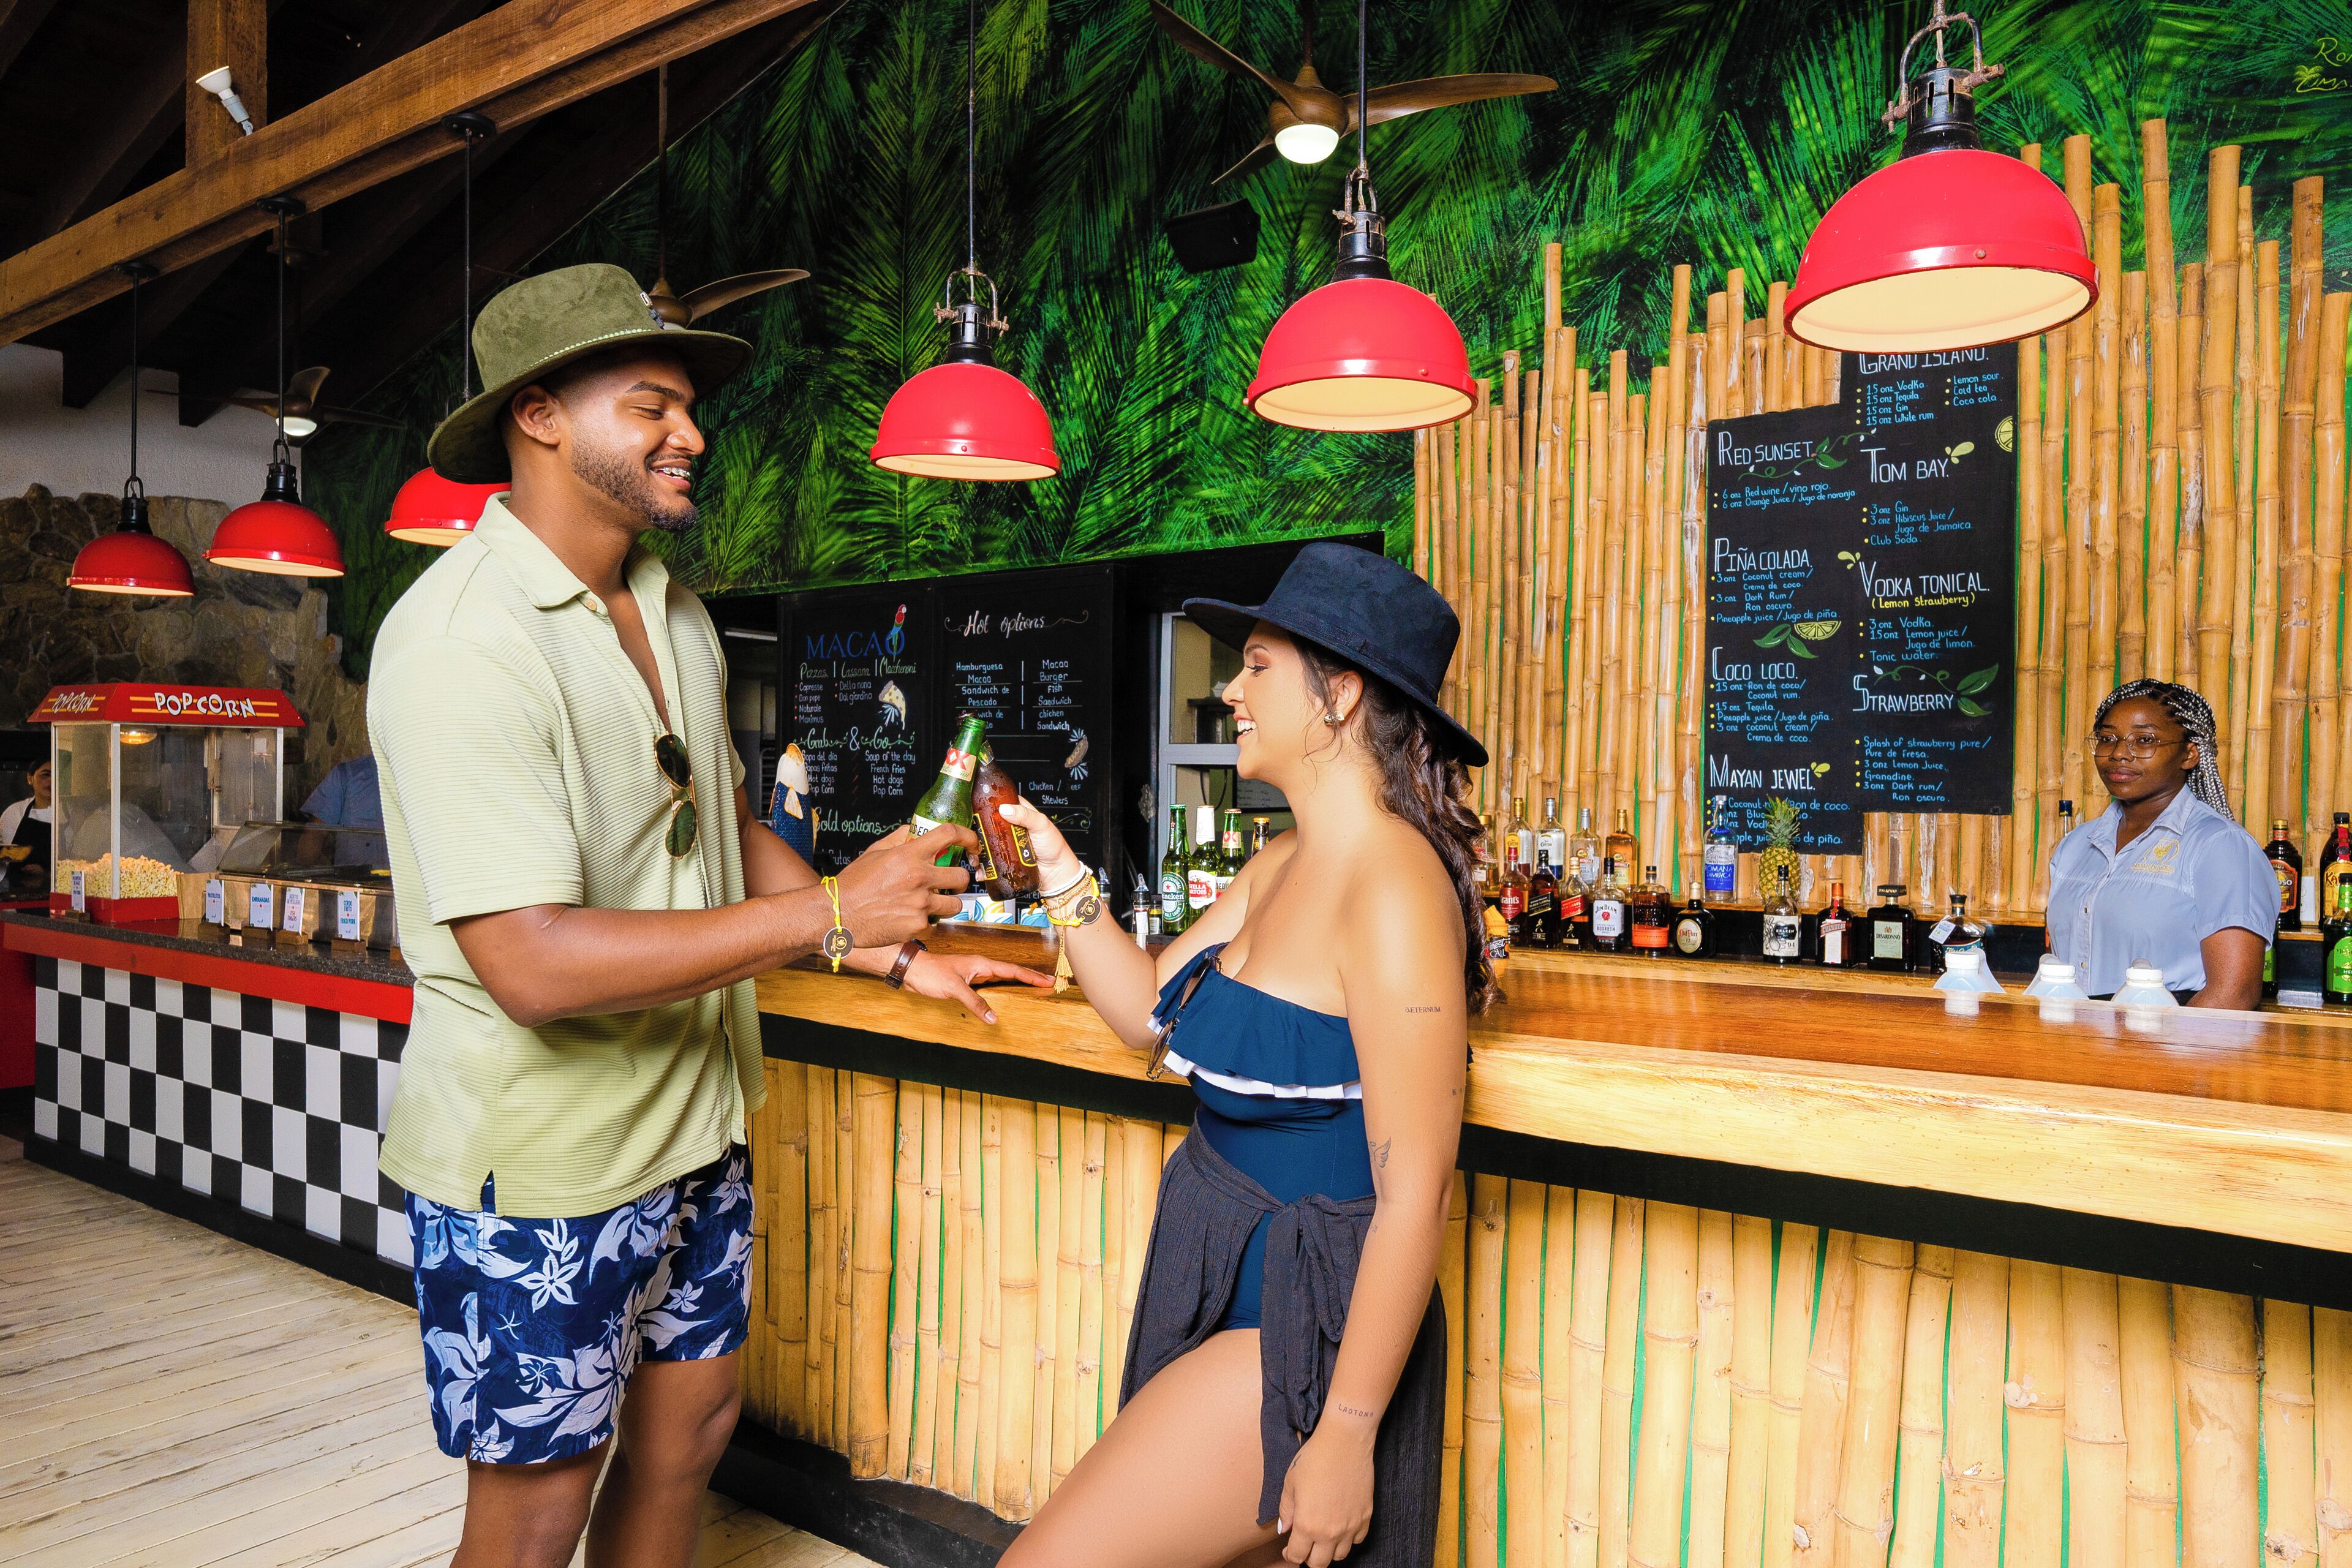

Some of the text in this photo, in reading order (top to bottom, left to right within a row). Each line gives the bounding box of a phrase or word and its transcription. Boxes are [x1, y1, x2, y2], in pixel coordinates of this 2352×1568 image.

[1954, 375, 1978, 385] Lemon
[1954, 386, 1971, 396] Cold
[1953, 397, 1974, 406] Coca
[1894, 413, 1917, 423] White
[1755, 441, 1813, 462] SUNSET
[1860, 448, 1906, 483] TOM
[1746, 486, 1759, 497] Red
[1790, 484, 1808, 493] vino
[1746, 498, 1770, 510] Orange
[1798, 492, 1815, 505] Jugo
[1817, 491, 1826, 500] de
[1895, 514, 1926, 524] Hibiscus
[1928, 510, 1946, 521] Juice
[1894, 524, 1929, 537] Jugo de
[1871, 535, 1891, 545] Club
[1760, 549, 1812, 571] COLADA.
[1743, 571, 1773, 581] Coconut
[1859, 562, 1990, 597] VODKA TONICAL.
[1717, 610, 1813, 624] Pineapple juice Jugo de
[964, 611, 1046, 638] Hot options
[1906, 629, 1934, 638] Lemon
[1938, 630, 1959, 641] juice
[807, 628, 905, 660] MACAO
[1905, 639, 1940, 652] Jugo de
[1869, 651, 1896, 661] Tonic
[956, 663, 1003, 673] Hamburguesa
[1042, 660, 1068, 669] Macao
[1713, 647, 1798, 680] COCO LOCO.
[968, 674, 992, 683] Macao
[1040, 672, 1068, 684] Burger
[840, 680, 856, 690] Della
[1748, 681, 1776, 690] Ron de
[1748, 691, 1777, 699] Coconut
[1853, 675, 1954, 712] STRAWBERRY
[54, 692, 96, 714] POPCORN
[154, 692, 256, 718] POPCORN
[1038, 696, 1072, 706] Sandwich
[1746, 701, 1775, 712] Tequila.
[799, 715, 823, 723] Maximus
[1717, 712, 1751, 723] Pineapple
[1754, 715, 1772, 724] juice
[1779, 712, 1796, 723] Jugo
[1037, 721, 1069, 731] Sandwich
[1747, 733, 1784, 742] Crema de
[1864, 736, 1980, 750] Splash of strawberry pure
[865, 750, 915, 764] Soup the day
[871, 764, 889, 773] French
[1893, 760, 1918, 769] Lemon
[1710, 754, 1815, 790] MAYAN JEWEL.
[1865, 771, 1914, 781] Granadine.
[821, 775, 835, 786] dogs
[873, 775, 903, 787] Hot dogs
[873, 785, 903, 797] Pop Corn
[1728, 798, 1820, 810] Coconut de
[842, 810, 882, 837] options
[1804, 833, 1815, 843] de
[1604, 905, 1617, 914] BEAM
